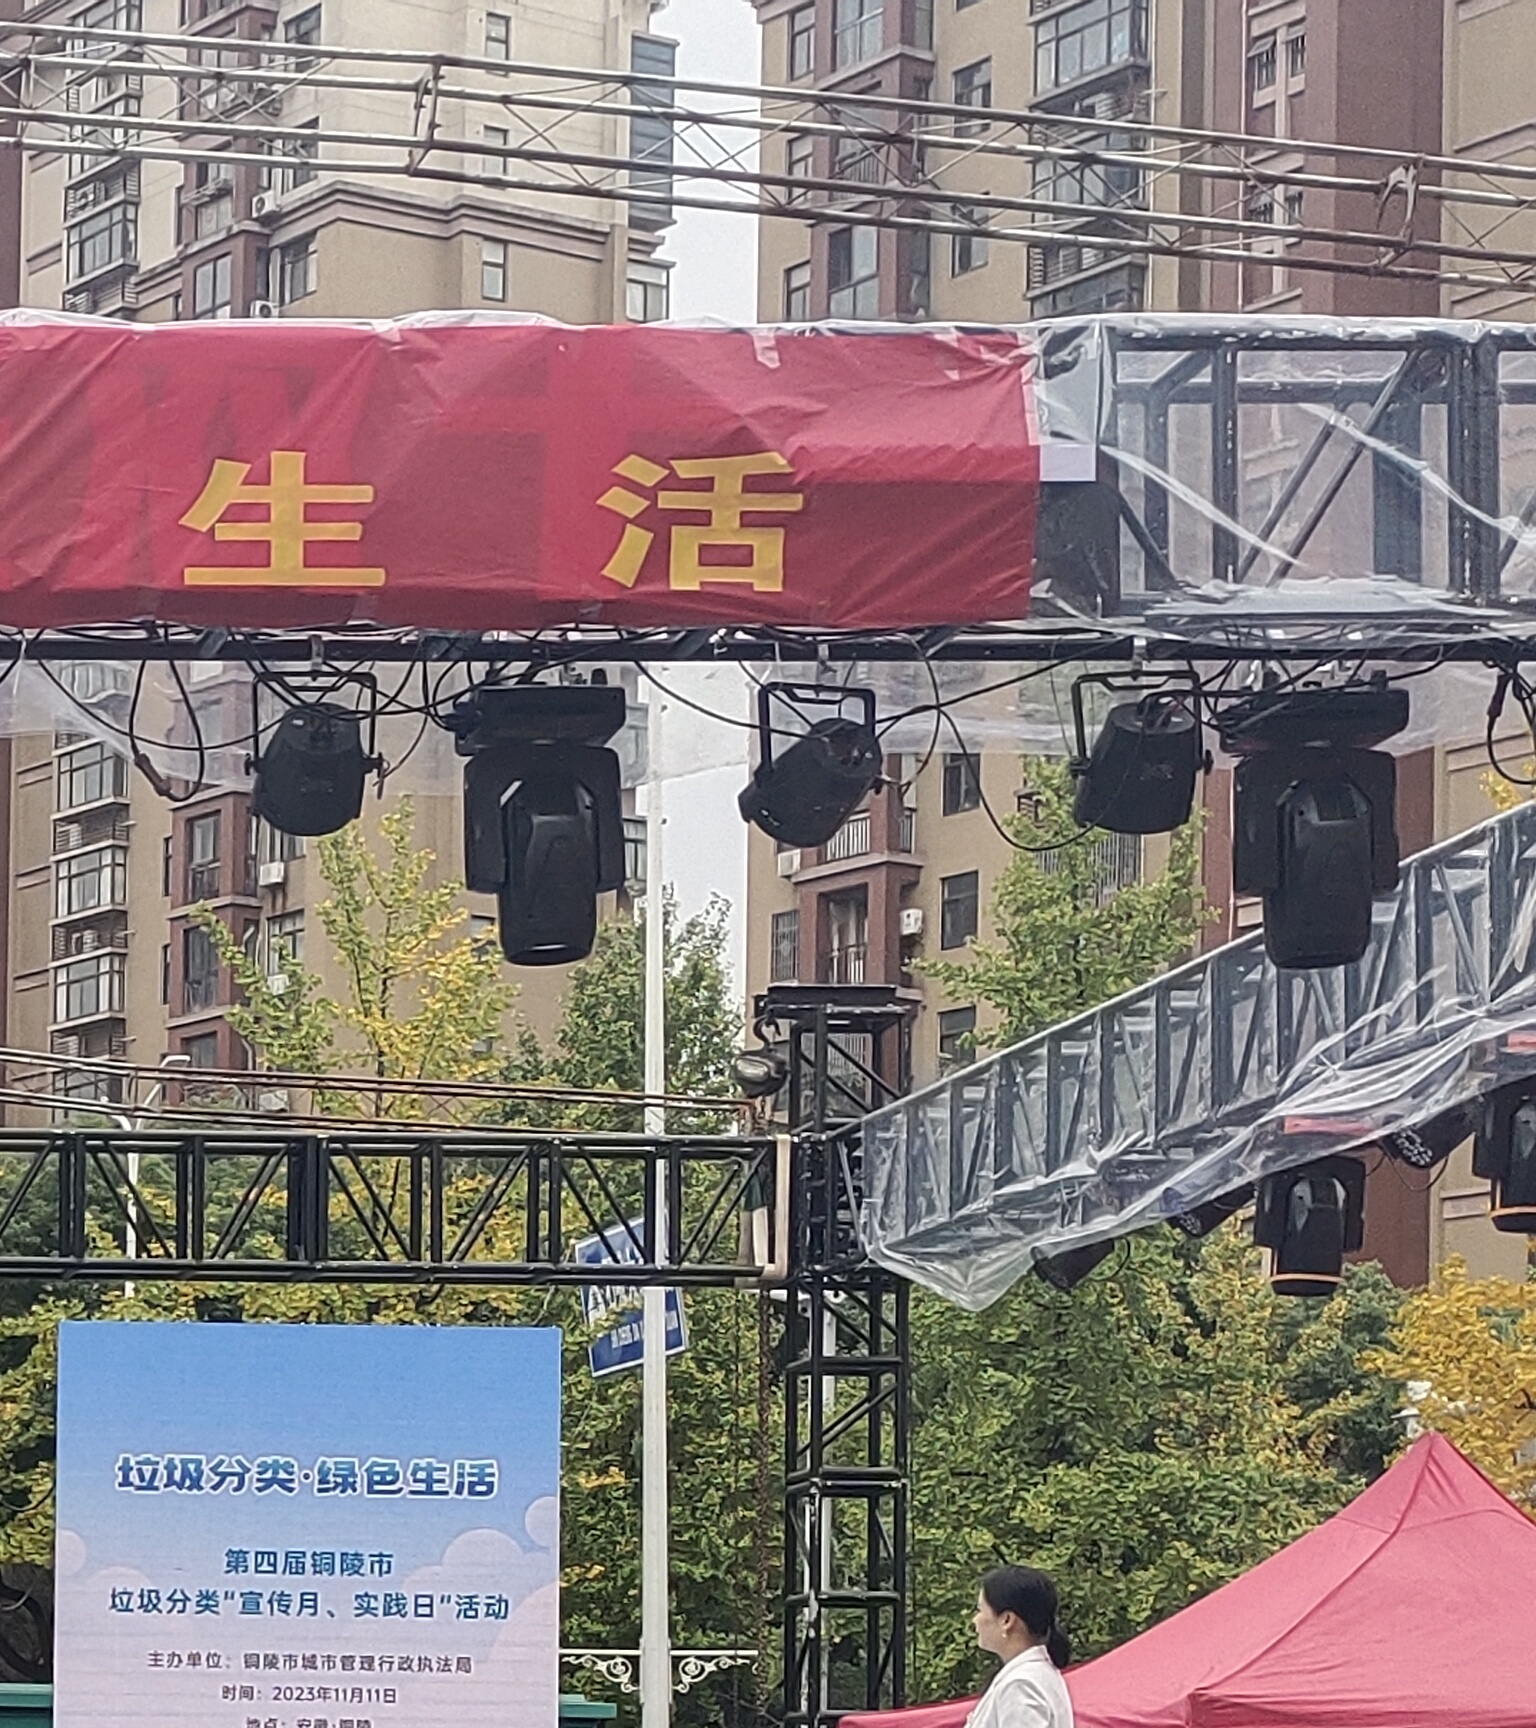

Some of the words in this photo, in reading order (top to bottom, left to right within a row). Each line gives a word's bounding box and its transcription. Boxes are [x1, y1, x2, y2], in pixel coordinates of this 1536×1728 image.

[114, 1455, 499, 1498] 垃圾分类·绿色生活
[224, 1548, 395, 1578] 第四届铜陵市
[221, 1685, 397, 1704] 时间：2023年11月11日
